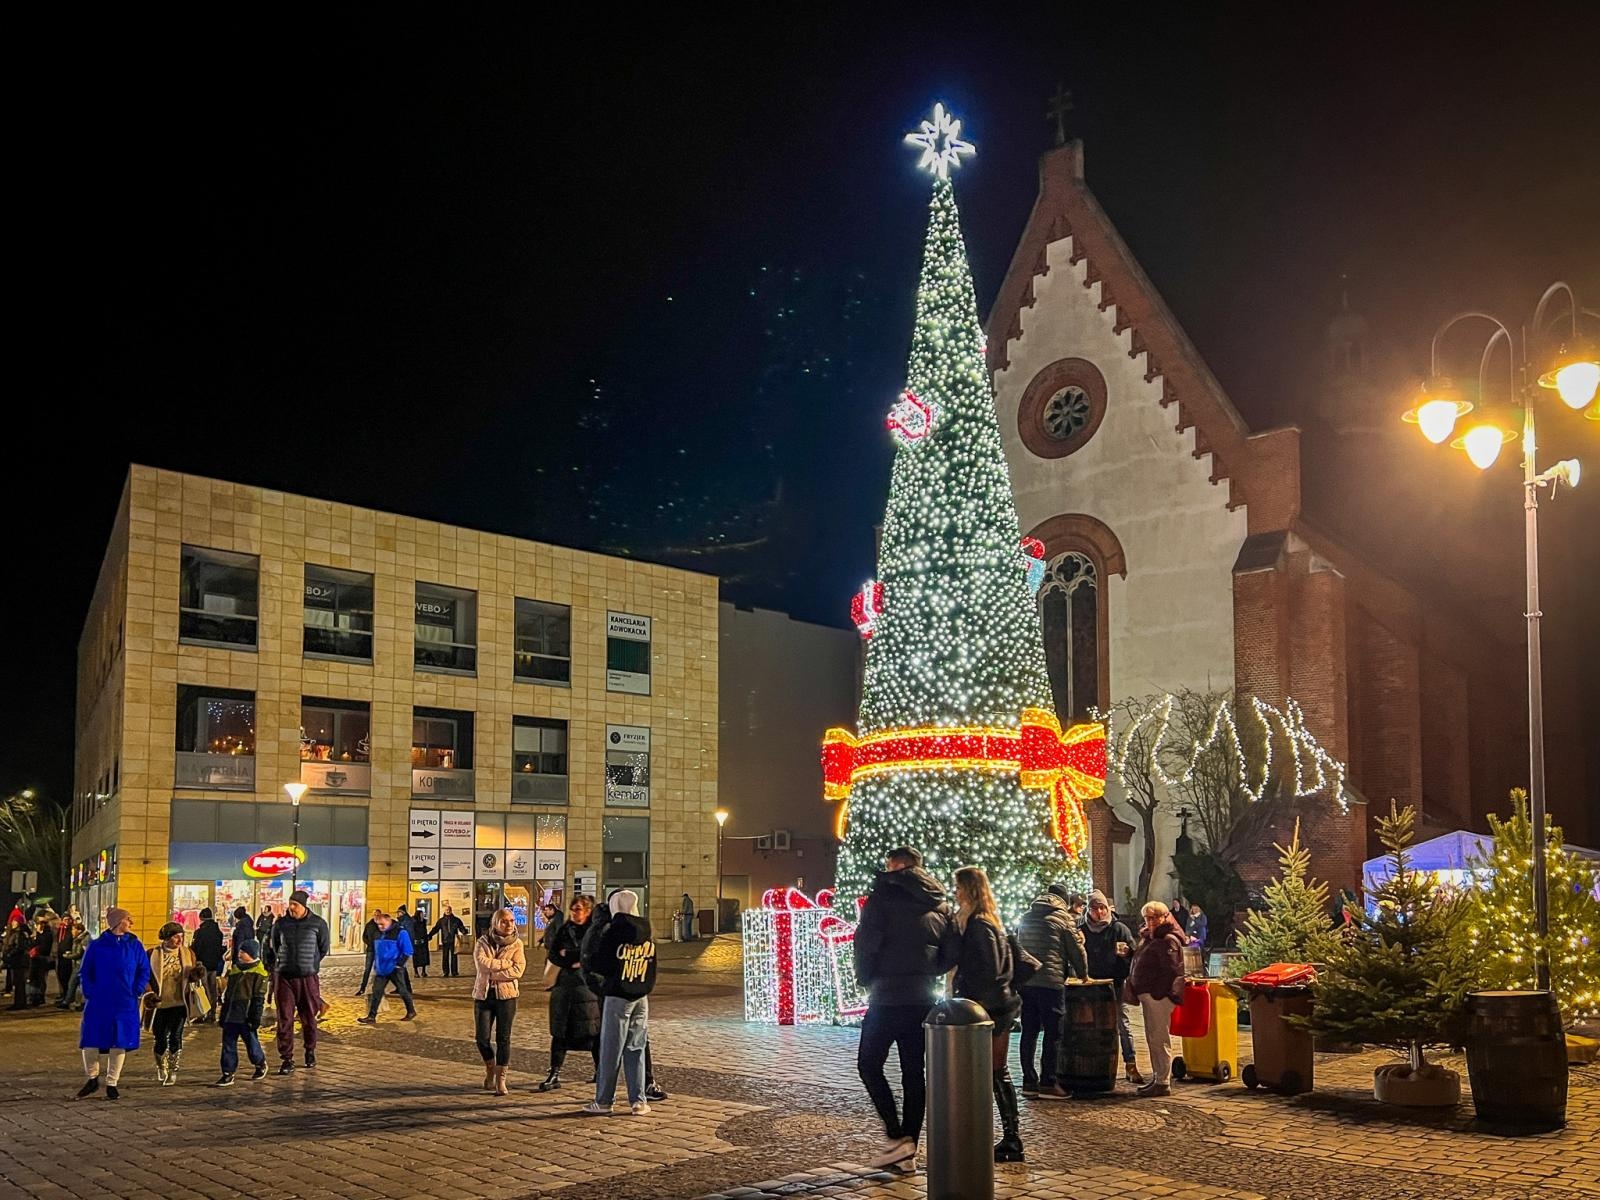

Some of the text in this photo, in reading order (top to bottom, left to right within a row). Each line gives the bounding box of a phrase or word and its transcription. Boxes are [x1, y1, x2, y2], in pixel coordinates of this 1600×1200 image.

[610, 616, 646, 627] KANCELARIA
[610, 625, 647, 636] ADWOKACKA
[623, 733, 646, 741] FRYZJER
[253, 856, 300, 868] PEPCO
[539, 863, 560, 871] LODY
